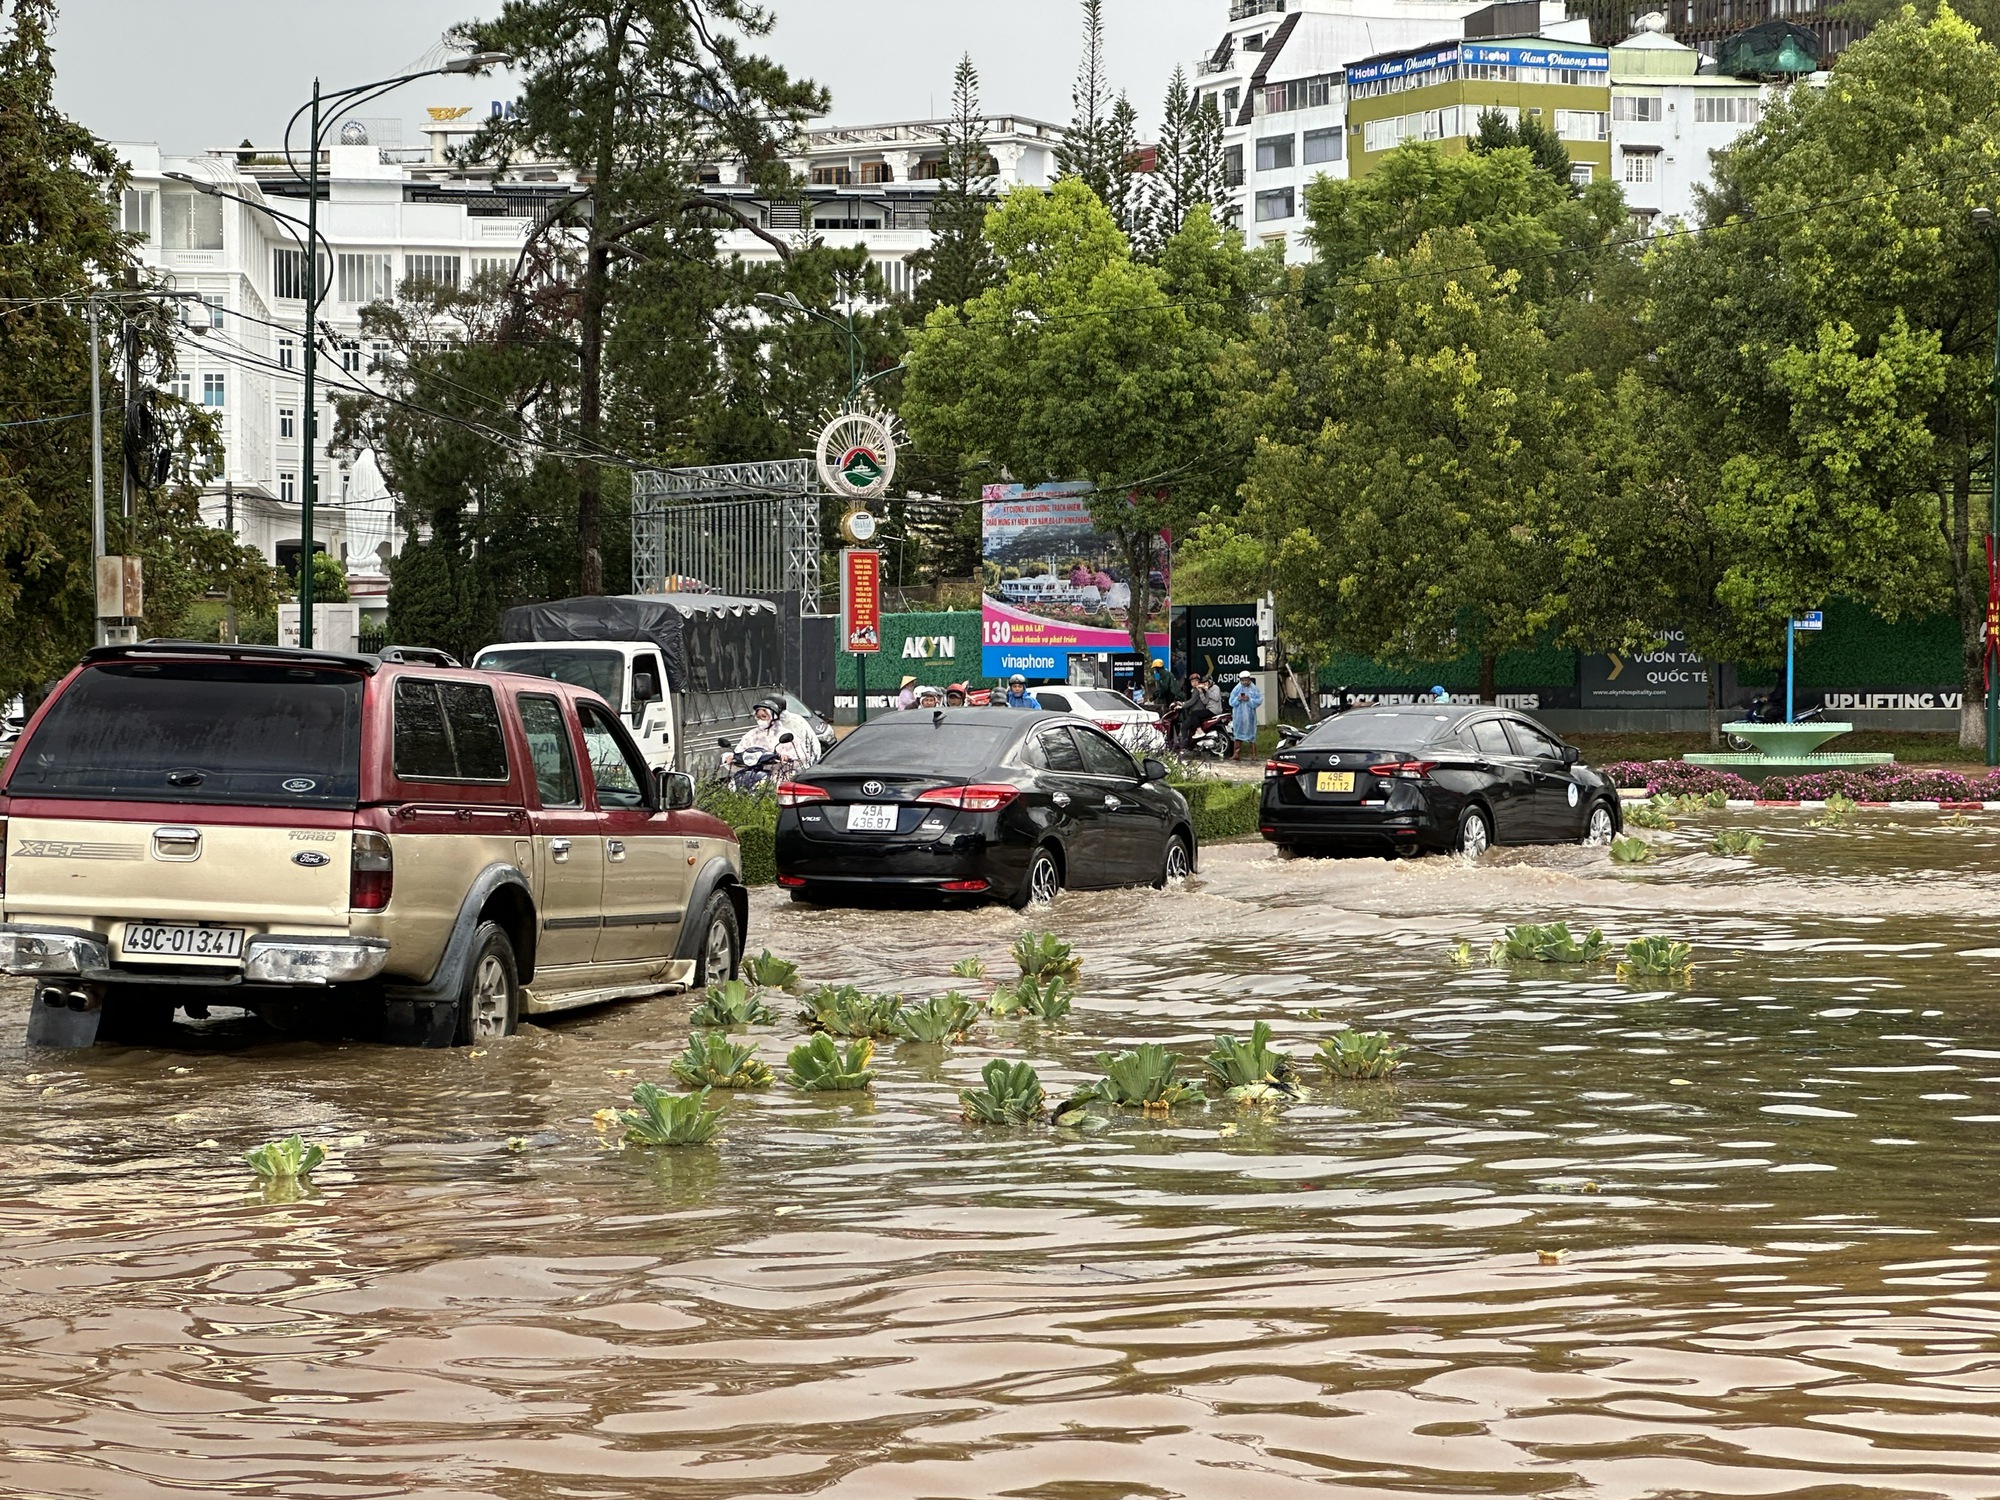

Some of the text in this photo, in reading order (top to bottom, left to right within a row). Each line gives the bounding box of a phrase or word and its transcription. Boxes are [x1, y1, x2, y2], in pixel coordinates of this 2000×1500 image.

[1479, 50, 1510, 62] Hotel
[1519, 51, 1545, 64] Nam
[1354, 67, 1378, 80] Hotel
[1380, 62, 1403, 75] Nam
[1196, 617, 1258, 628] LOCAL WISDOM
[983, 621, 1011, 644] 130
[902, 636, 955, 658] AKYN
[1197, 637, 1236, 647] LEADS TO
[1001, 654, 1055, 669] vinaphone
[1217, 654, 1250, 665] GLOBAL
[1646, 668, 1689, 684] QUỐC
[1592, 689, 1666, 697] www.akynhospitality.com
[834, 695, 887, 708] UPLITING
[1319, 693, 1375, 709] UNOCK
[1378, 693, 1414, 705] NEW
[1824, 693, 1934, 708] UPLIFTING
[1327, 772, 1344, 782] 49E
[290, 780, 308, 789] Ford
[1320, 782, 1349, 791] 011.12
[862, 806, 883, 817] 49A
[852, 818, 891, 829] 436.87
[288, 834, 336, 842] TURBO
[299, 853, 320, 863] Ford
[127, 927, 236, 954] 49C-013.41
